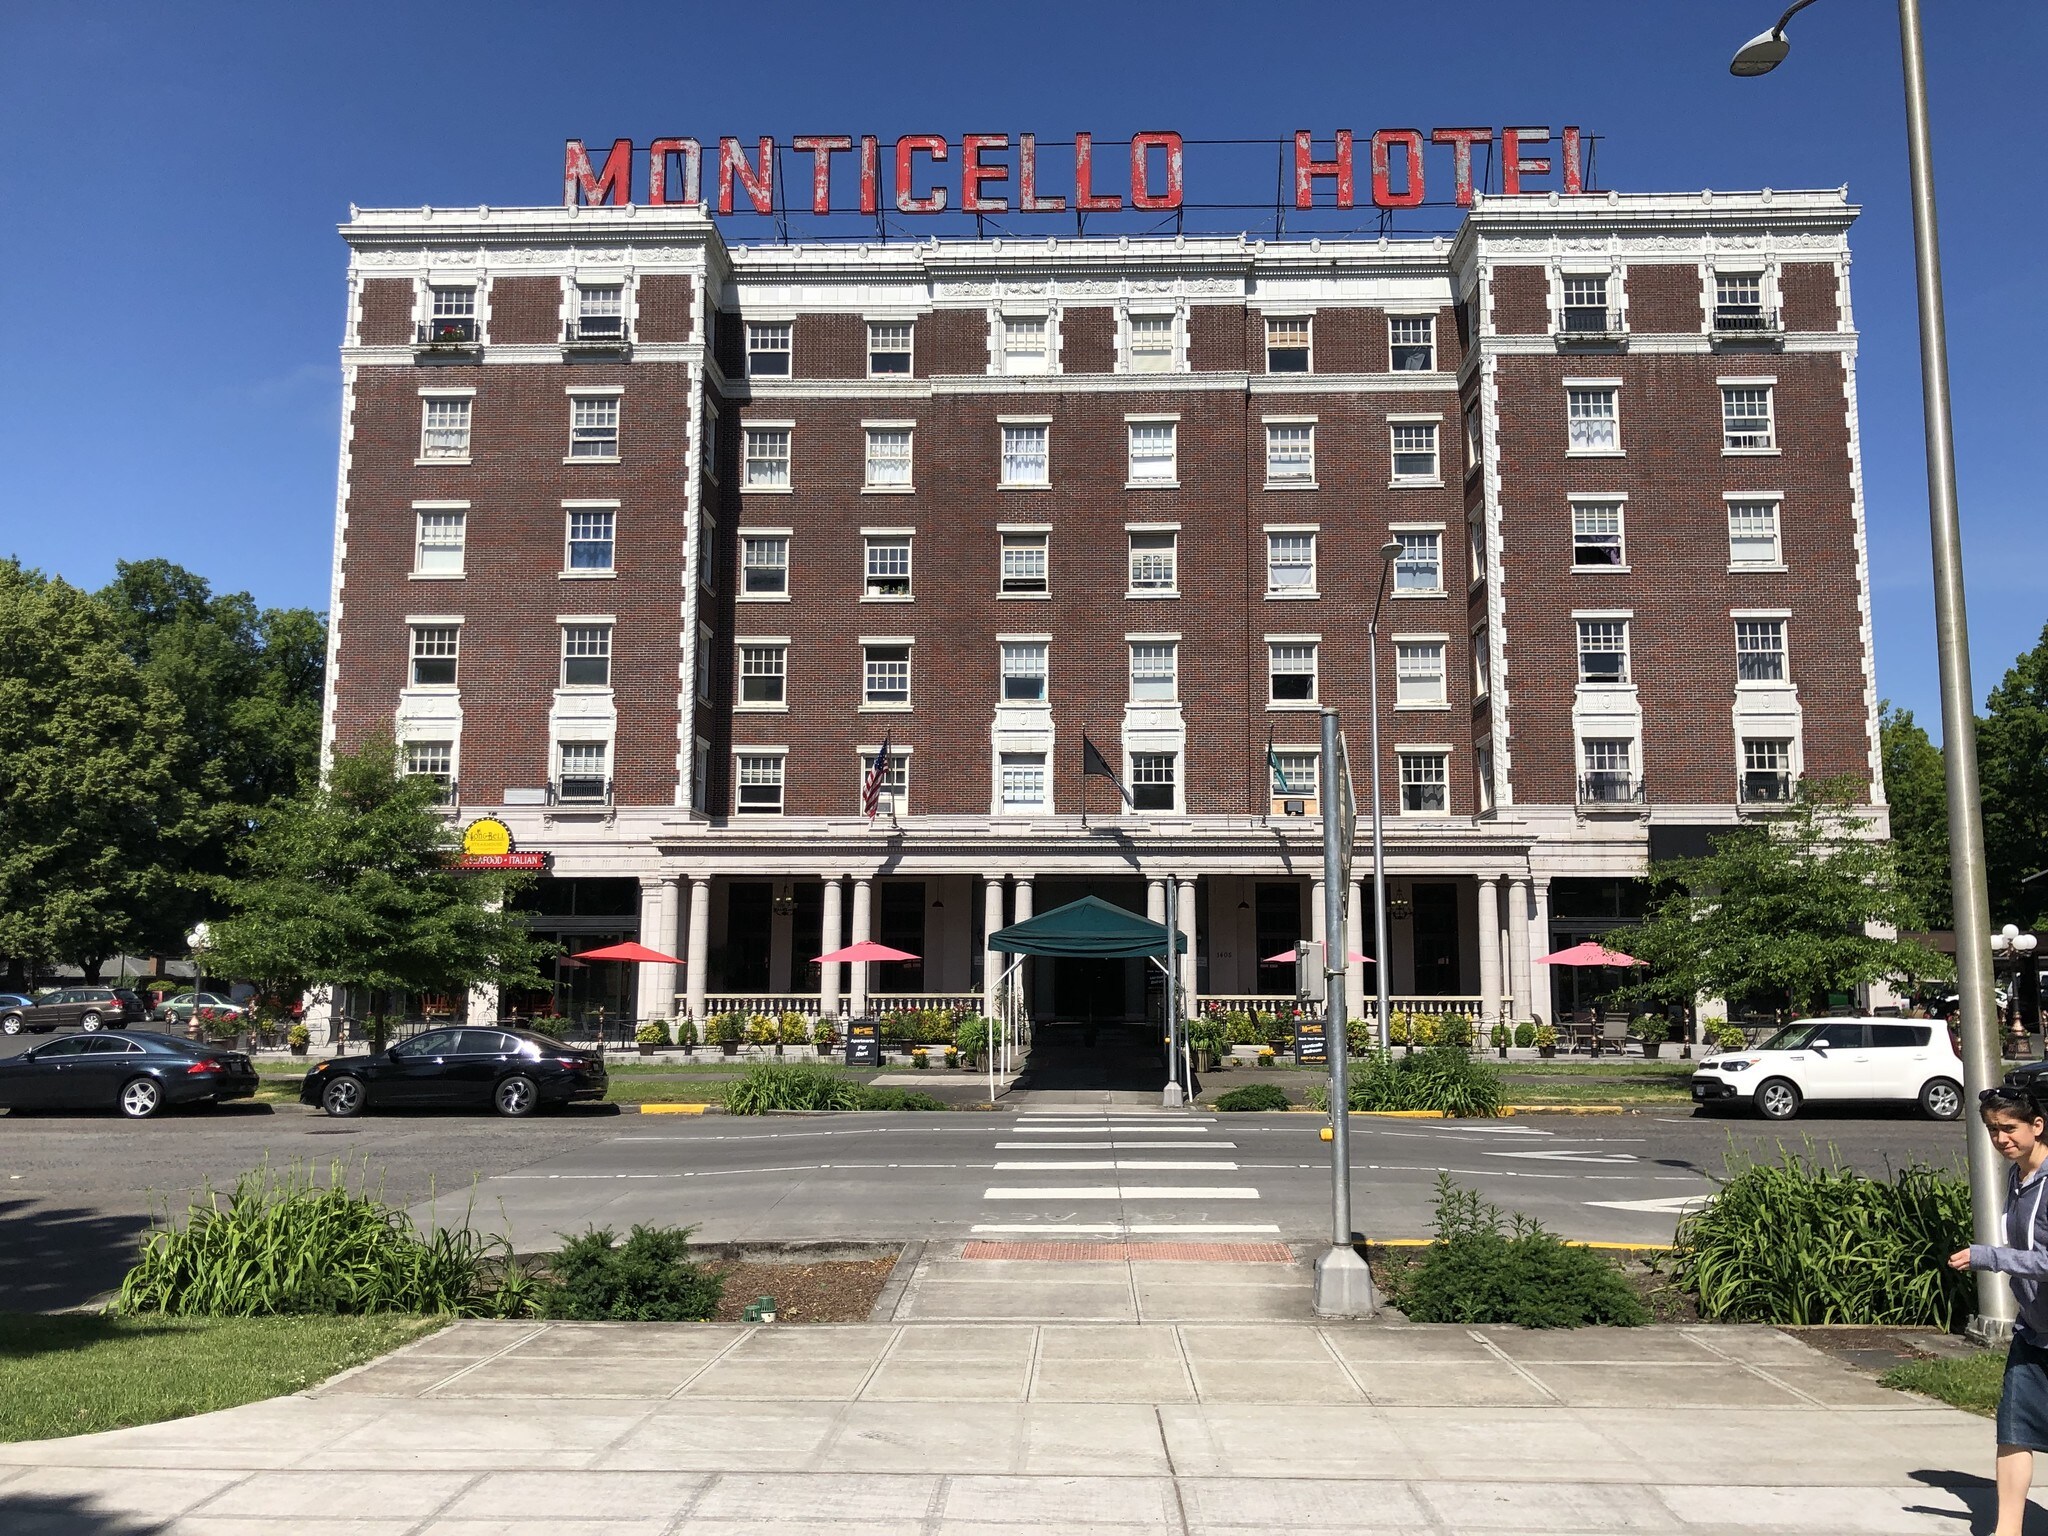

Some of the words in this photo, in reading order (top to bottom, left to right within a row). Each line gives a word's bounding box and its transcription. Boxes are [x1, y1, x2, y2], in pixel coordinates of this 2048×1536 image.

[563, 131, 1184, 216] MONTICELLO
[1294, 126, 1610, 210] HOTEL
[508, 856, 538, 865] ITALIAN
